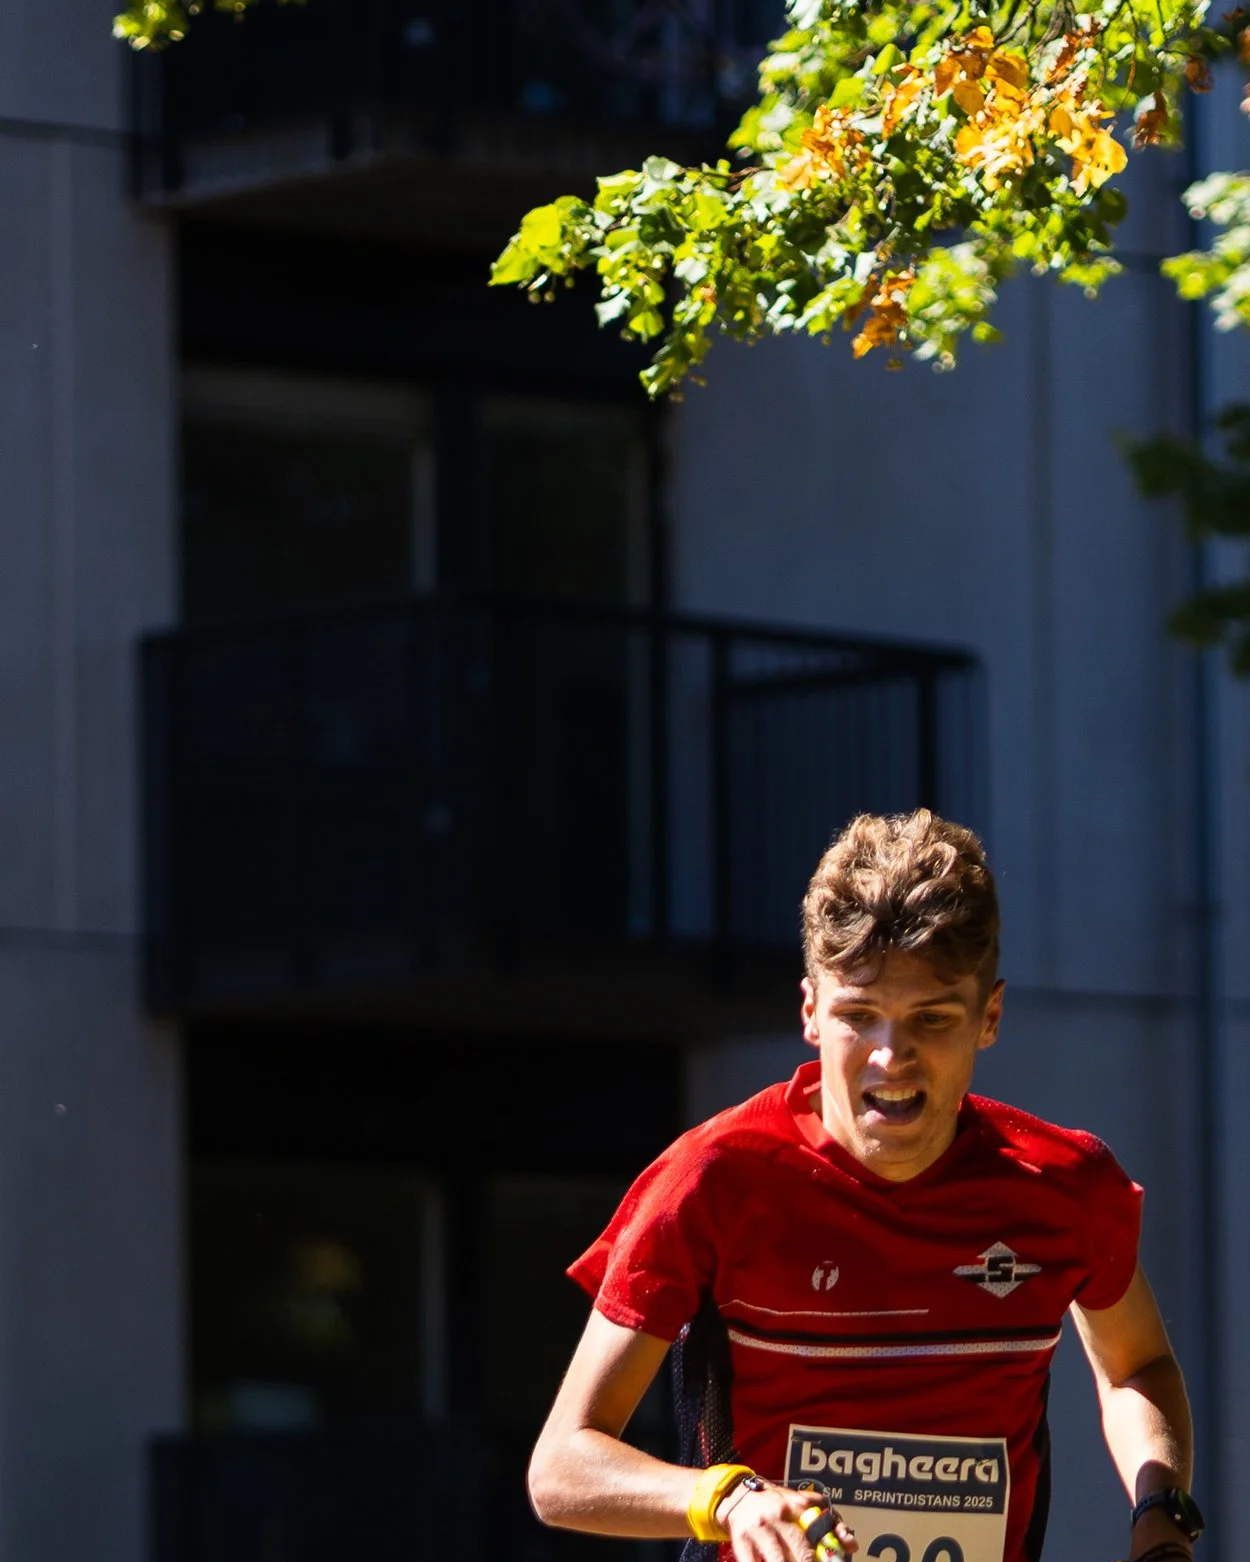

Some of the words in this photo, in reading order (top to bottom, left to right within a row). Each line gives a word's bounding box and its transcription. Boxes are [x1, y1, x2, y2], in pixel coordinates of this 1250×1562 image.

[801, 1441, 999, 1484] bagheera
[823, 1486, 842, 1500] SM
[854, 1489, 960, 1507] SPRINTDISTANS
[963, 1495, 993, 1508] 2025
